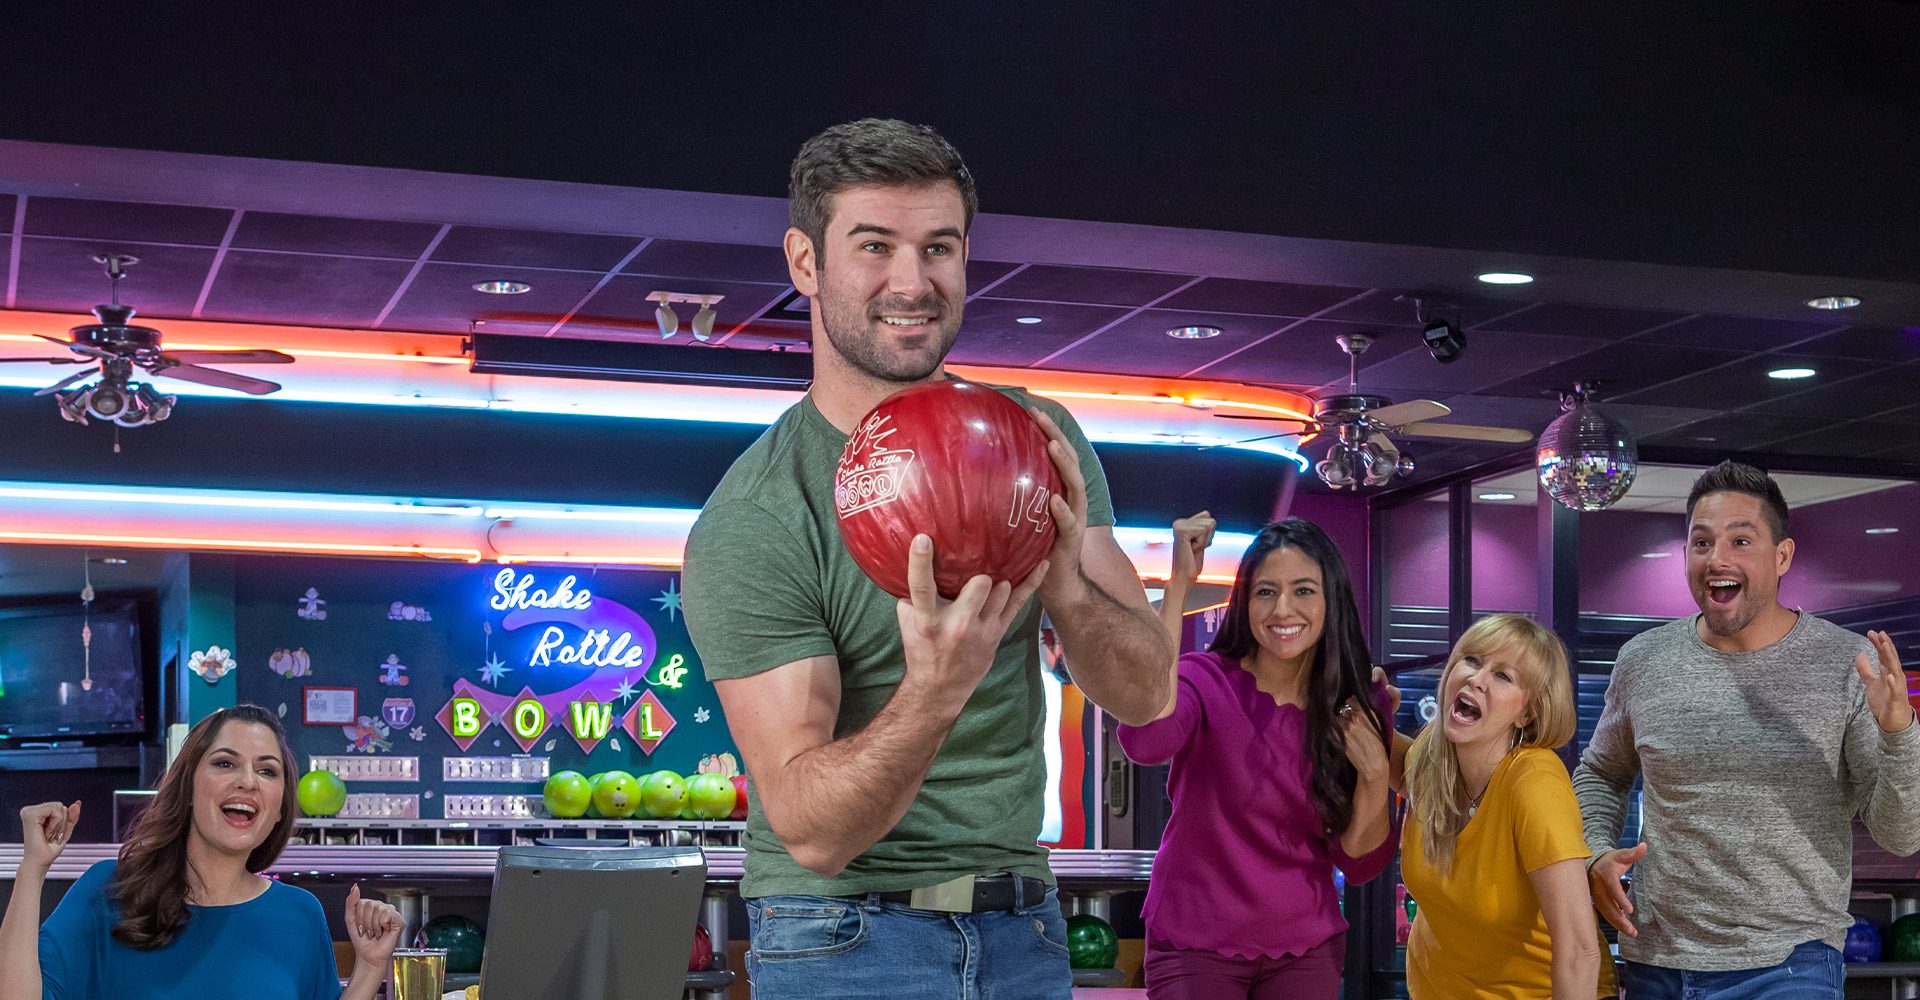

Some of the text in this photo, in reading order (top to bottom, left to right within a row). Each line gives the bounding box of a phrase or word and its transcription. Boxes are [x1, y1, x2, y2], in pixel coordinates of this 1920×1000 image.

[840, 454, 902, 482] Shake Rattle
[1008, 481, 1050, 533] 14
[490, 567, 592, 611] Shake
[529, 625, 689, 689] Rattle &
[389, 705, 409, 722] 17
[452, 697, 664, 740] BOWL
